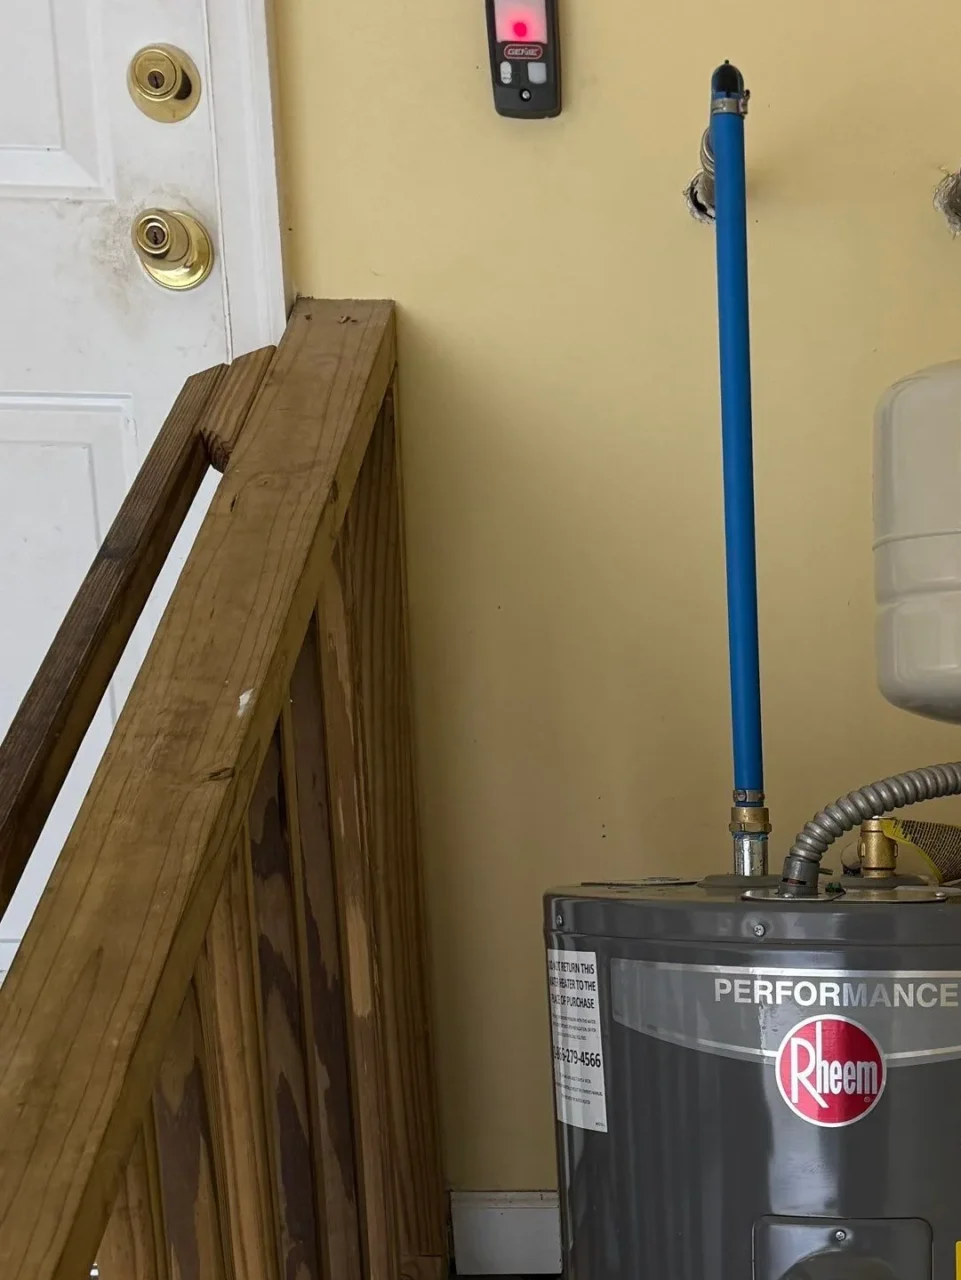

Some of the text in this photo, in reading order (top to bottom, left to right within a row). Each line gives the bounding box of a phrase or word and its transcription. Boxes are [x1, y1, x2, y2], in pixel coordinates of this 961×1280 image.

[581, 963, 594, 974] THIS
[576, 980, 584, 990] TO
[584, 980, 596, 991] THE
[790, 1021, 877, 1108] Rheem
